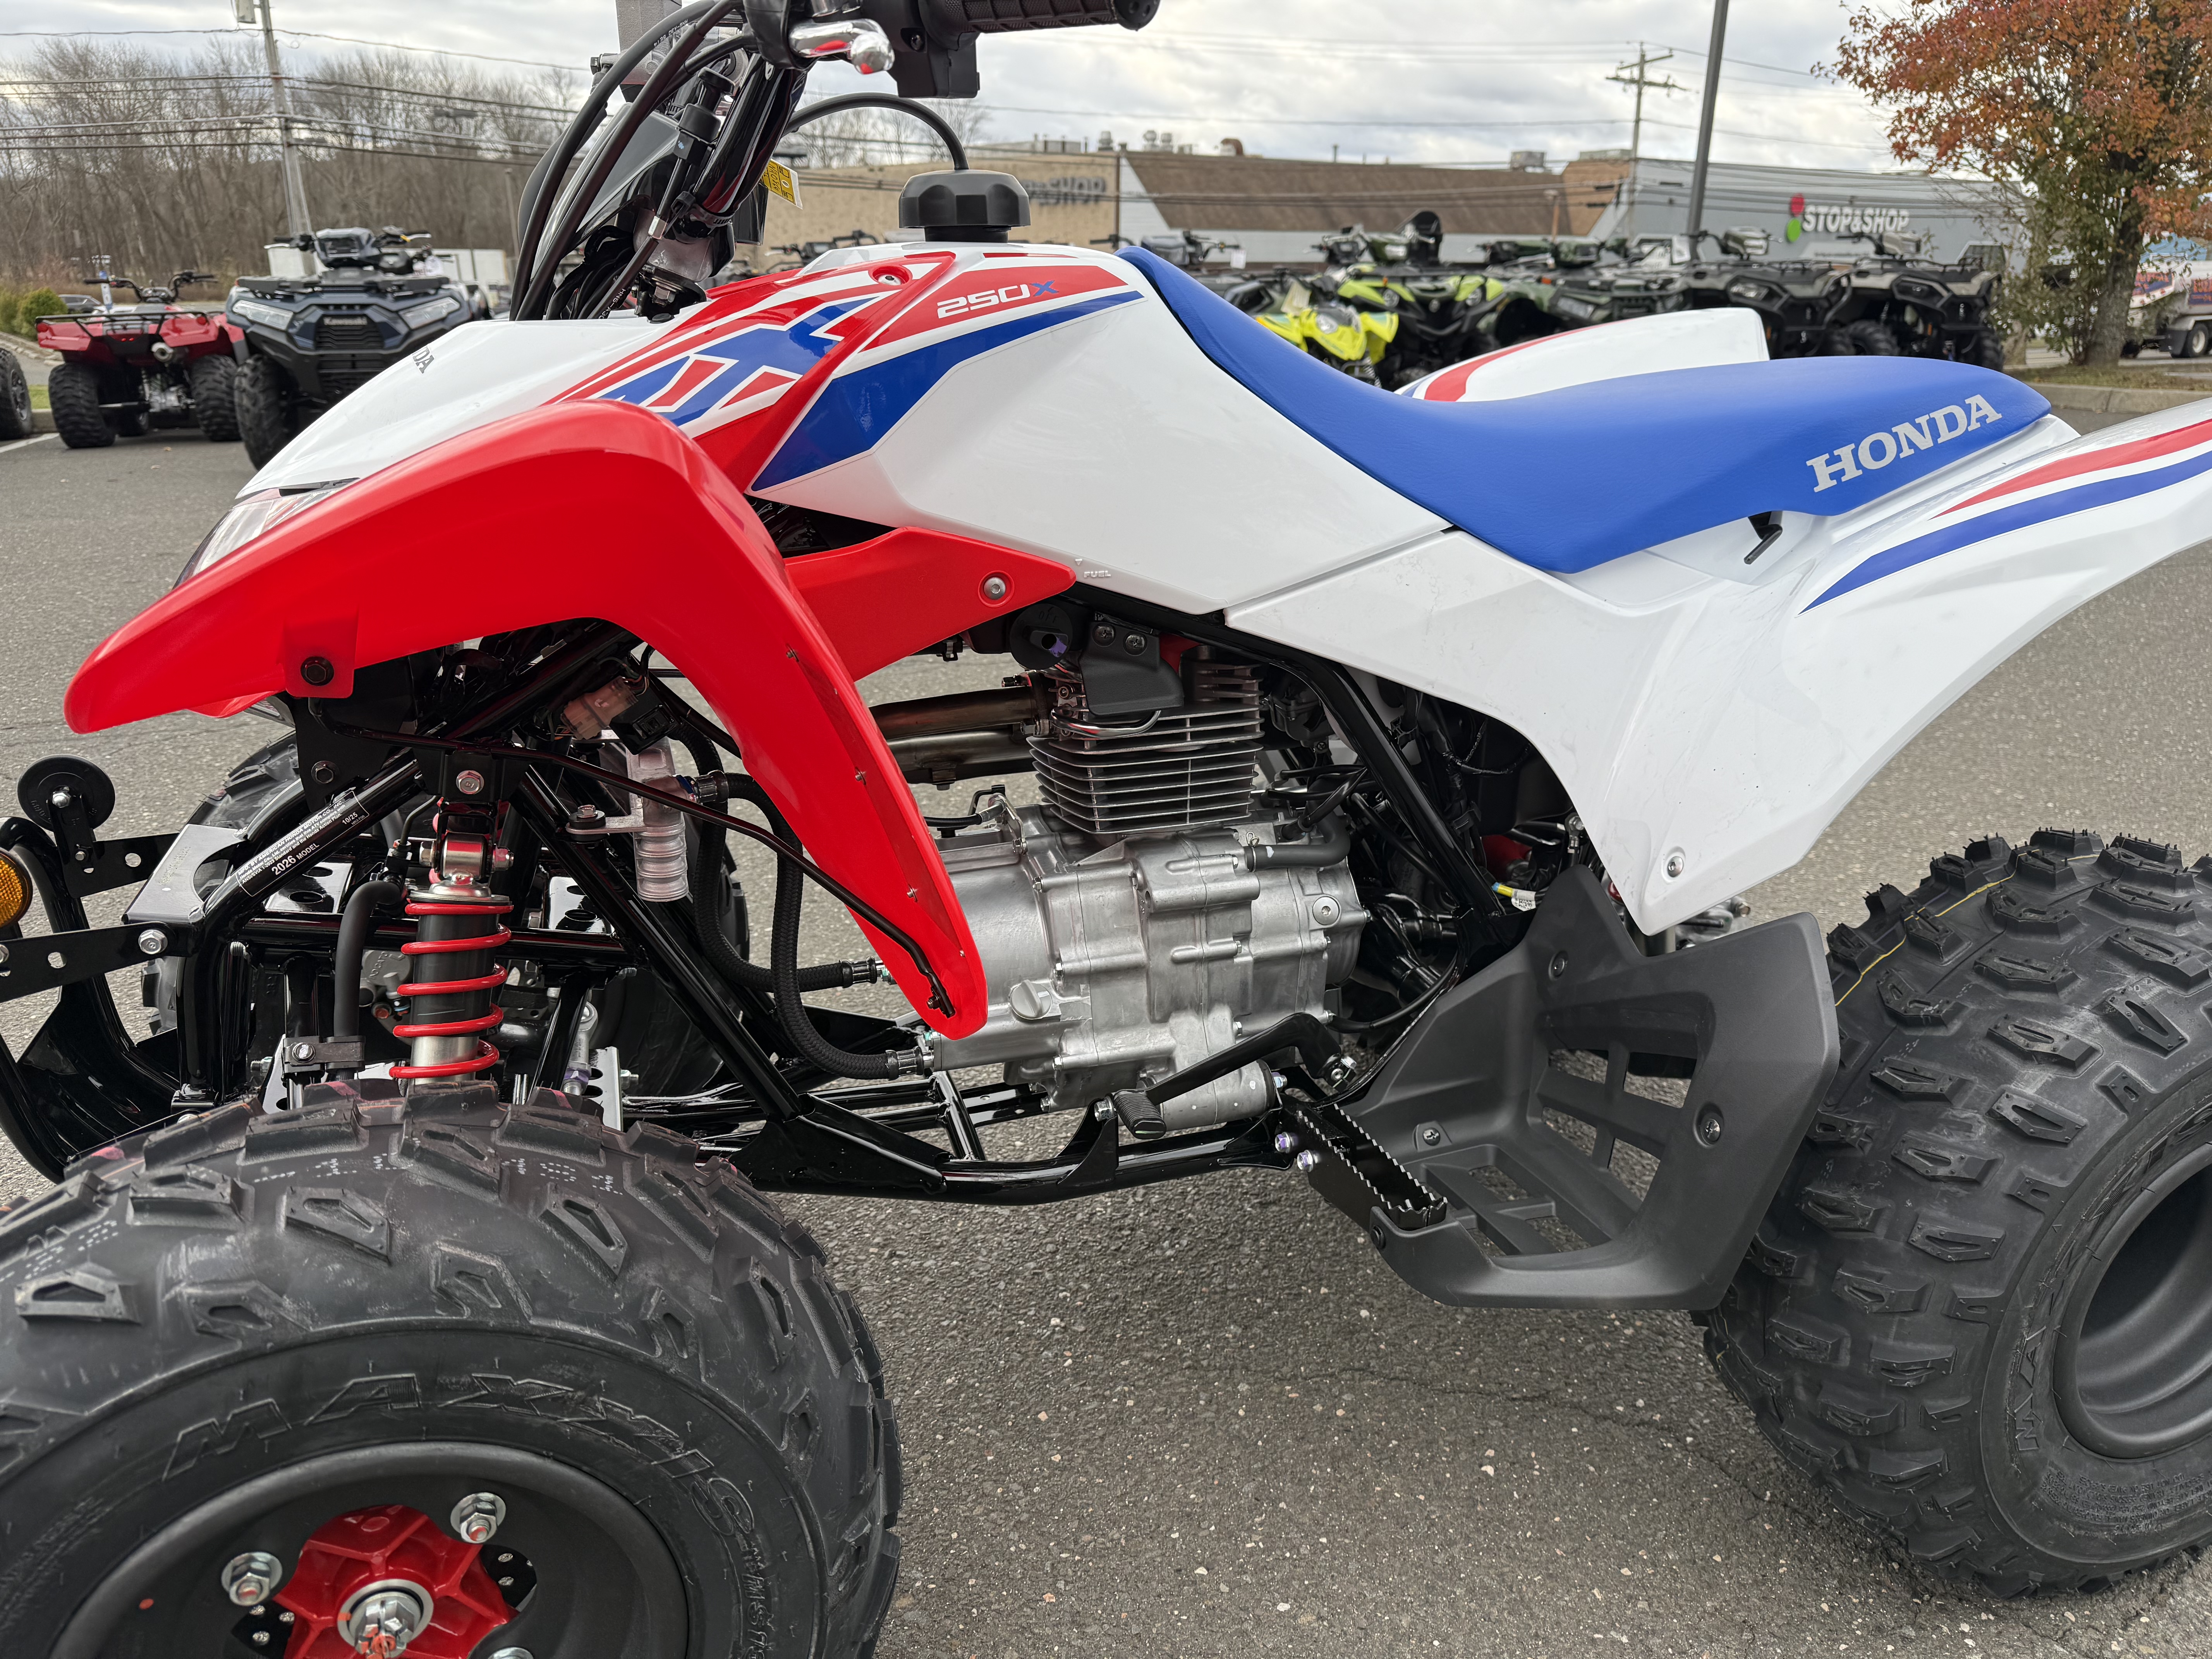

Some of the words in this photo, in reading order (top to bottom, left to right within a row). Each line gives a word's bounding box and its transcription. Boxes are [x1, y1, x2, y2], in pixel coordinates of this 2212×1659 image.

[937, 280, 1058, 319] 250X
[1805, 394, 2002, 492] HONDA
[1084, 570, 1111, 578] FUEL
[1038, 610, 1059, 623] OFF
[237, 865, 250, 875] MFD.
[257, 840, 285, 861] AMERICAN
[284, 827, 304, 842] HONDA
[303, 814, 323, 830] MOTOR
[332, 799, 344, 809] INC.
[239, 868, 253, 880] Honda
[251, 860, 264, 871] Motor
[278, 838, 296, 852] certifies
[295, 833, 304, 841] that
[310, 821, 320, 830] ATV
[319, 810, 337, 824] complies
[336, 804, 346, 812] with
[261, 859, 275, 870] 1-2023
[274, 846, 293, 861] Standard
[291, 841, 300, 849] and
[306, 827, 319, 839] Honda
[318, 819, 332, 830] Action
[331, 812, 342, 821] Plan.
[342, 811, 358, 826] 10/25
[270, 854, 297, 876] 2026
[295, 841, 319, 860] MODEL
[161, 1373, 755, 1536] MAXXIS
